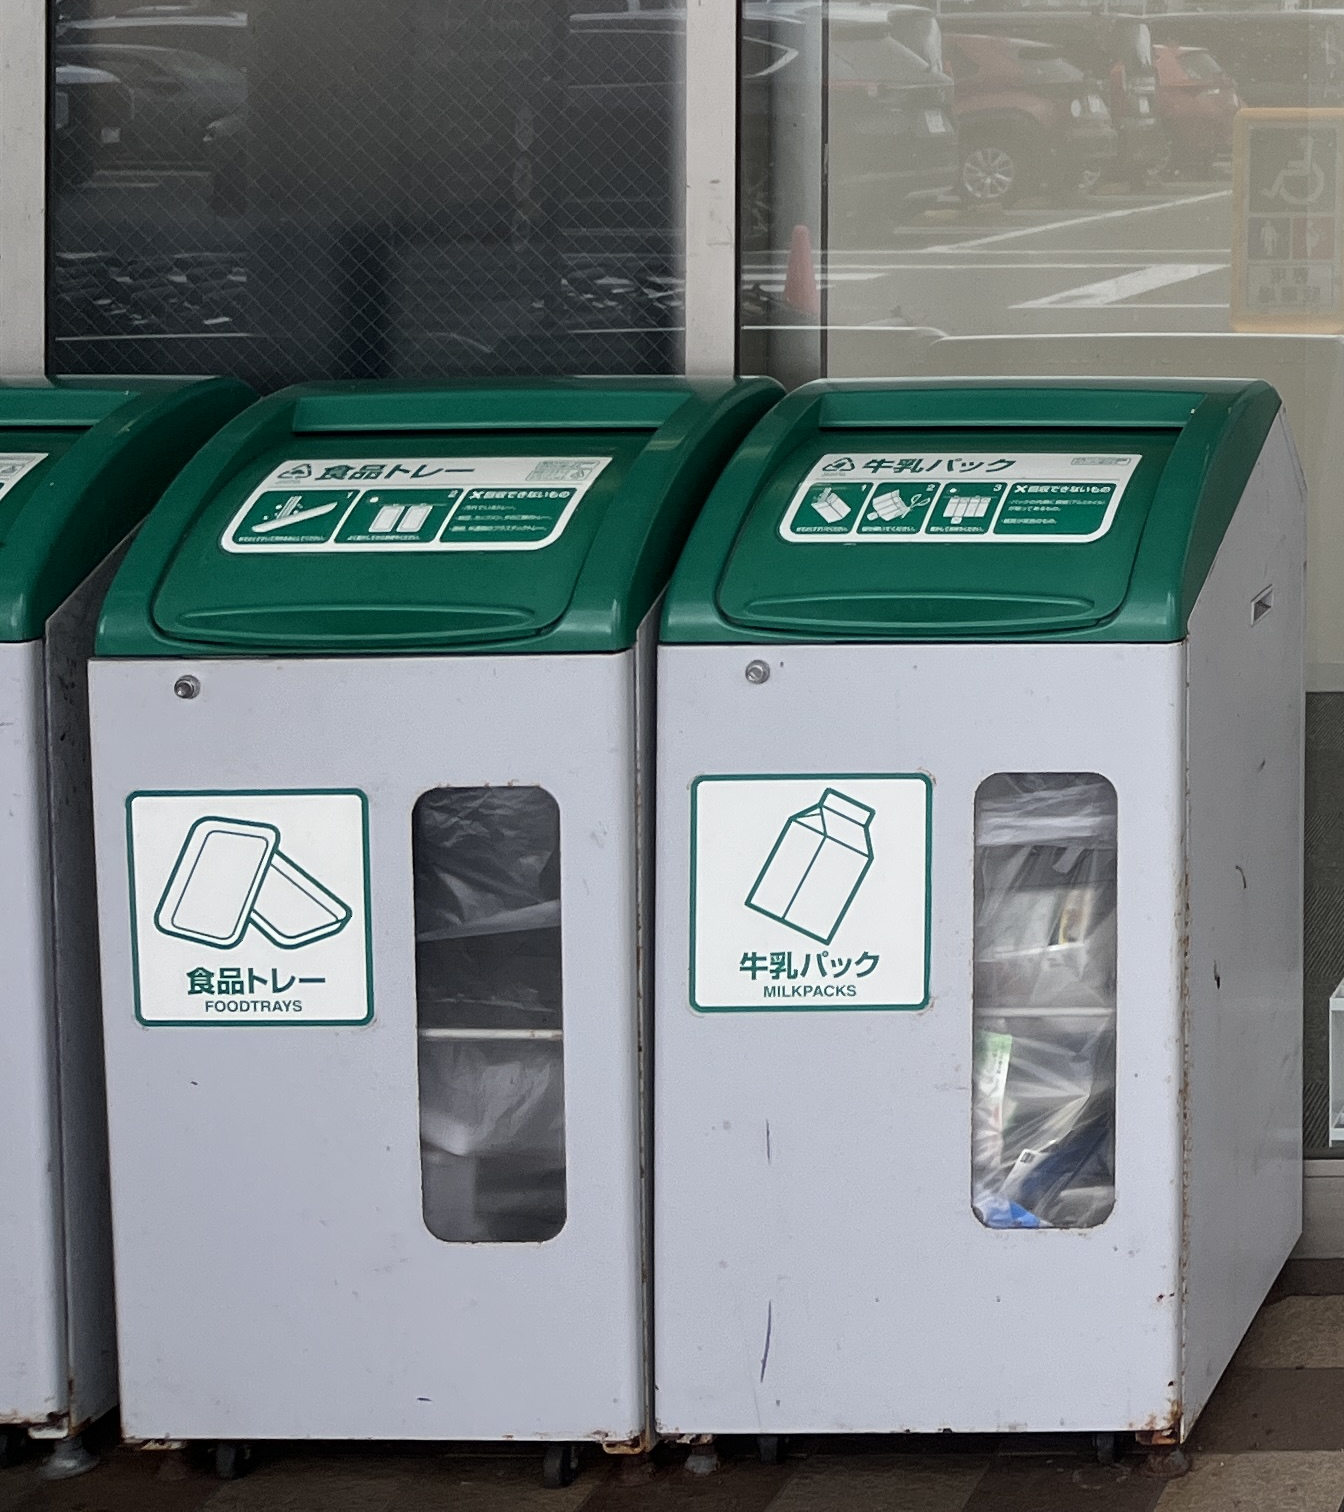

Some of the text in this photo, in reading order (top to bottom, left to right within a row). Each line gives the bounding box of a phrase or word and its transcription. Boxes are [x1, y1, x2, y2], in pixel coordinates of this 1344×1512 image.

[315, 464, 475, 481] 食品トレー
[862, 458, 1016, 474] 牛乳パック
[740, 951, 879, 980] 牛乳パック
[187, 967, 325, 995] 食品トレー
[764, 985, 857, 997] MILKPACKS
[205, 1000, 302, 1012] FOODTRAYS
